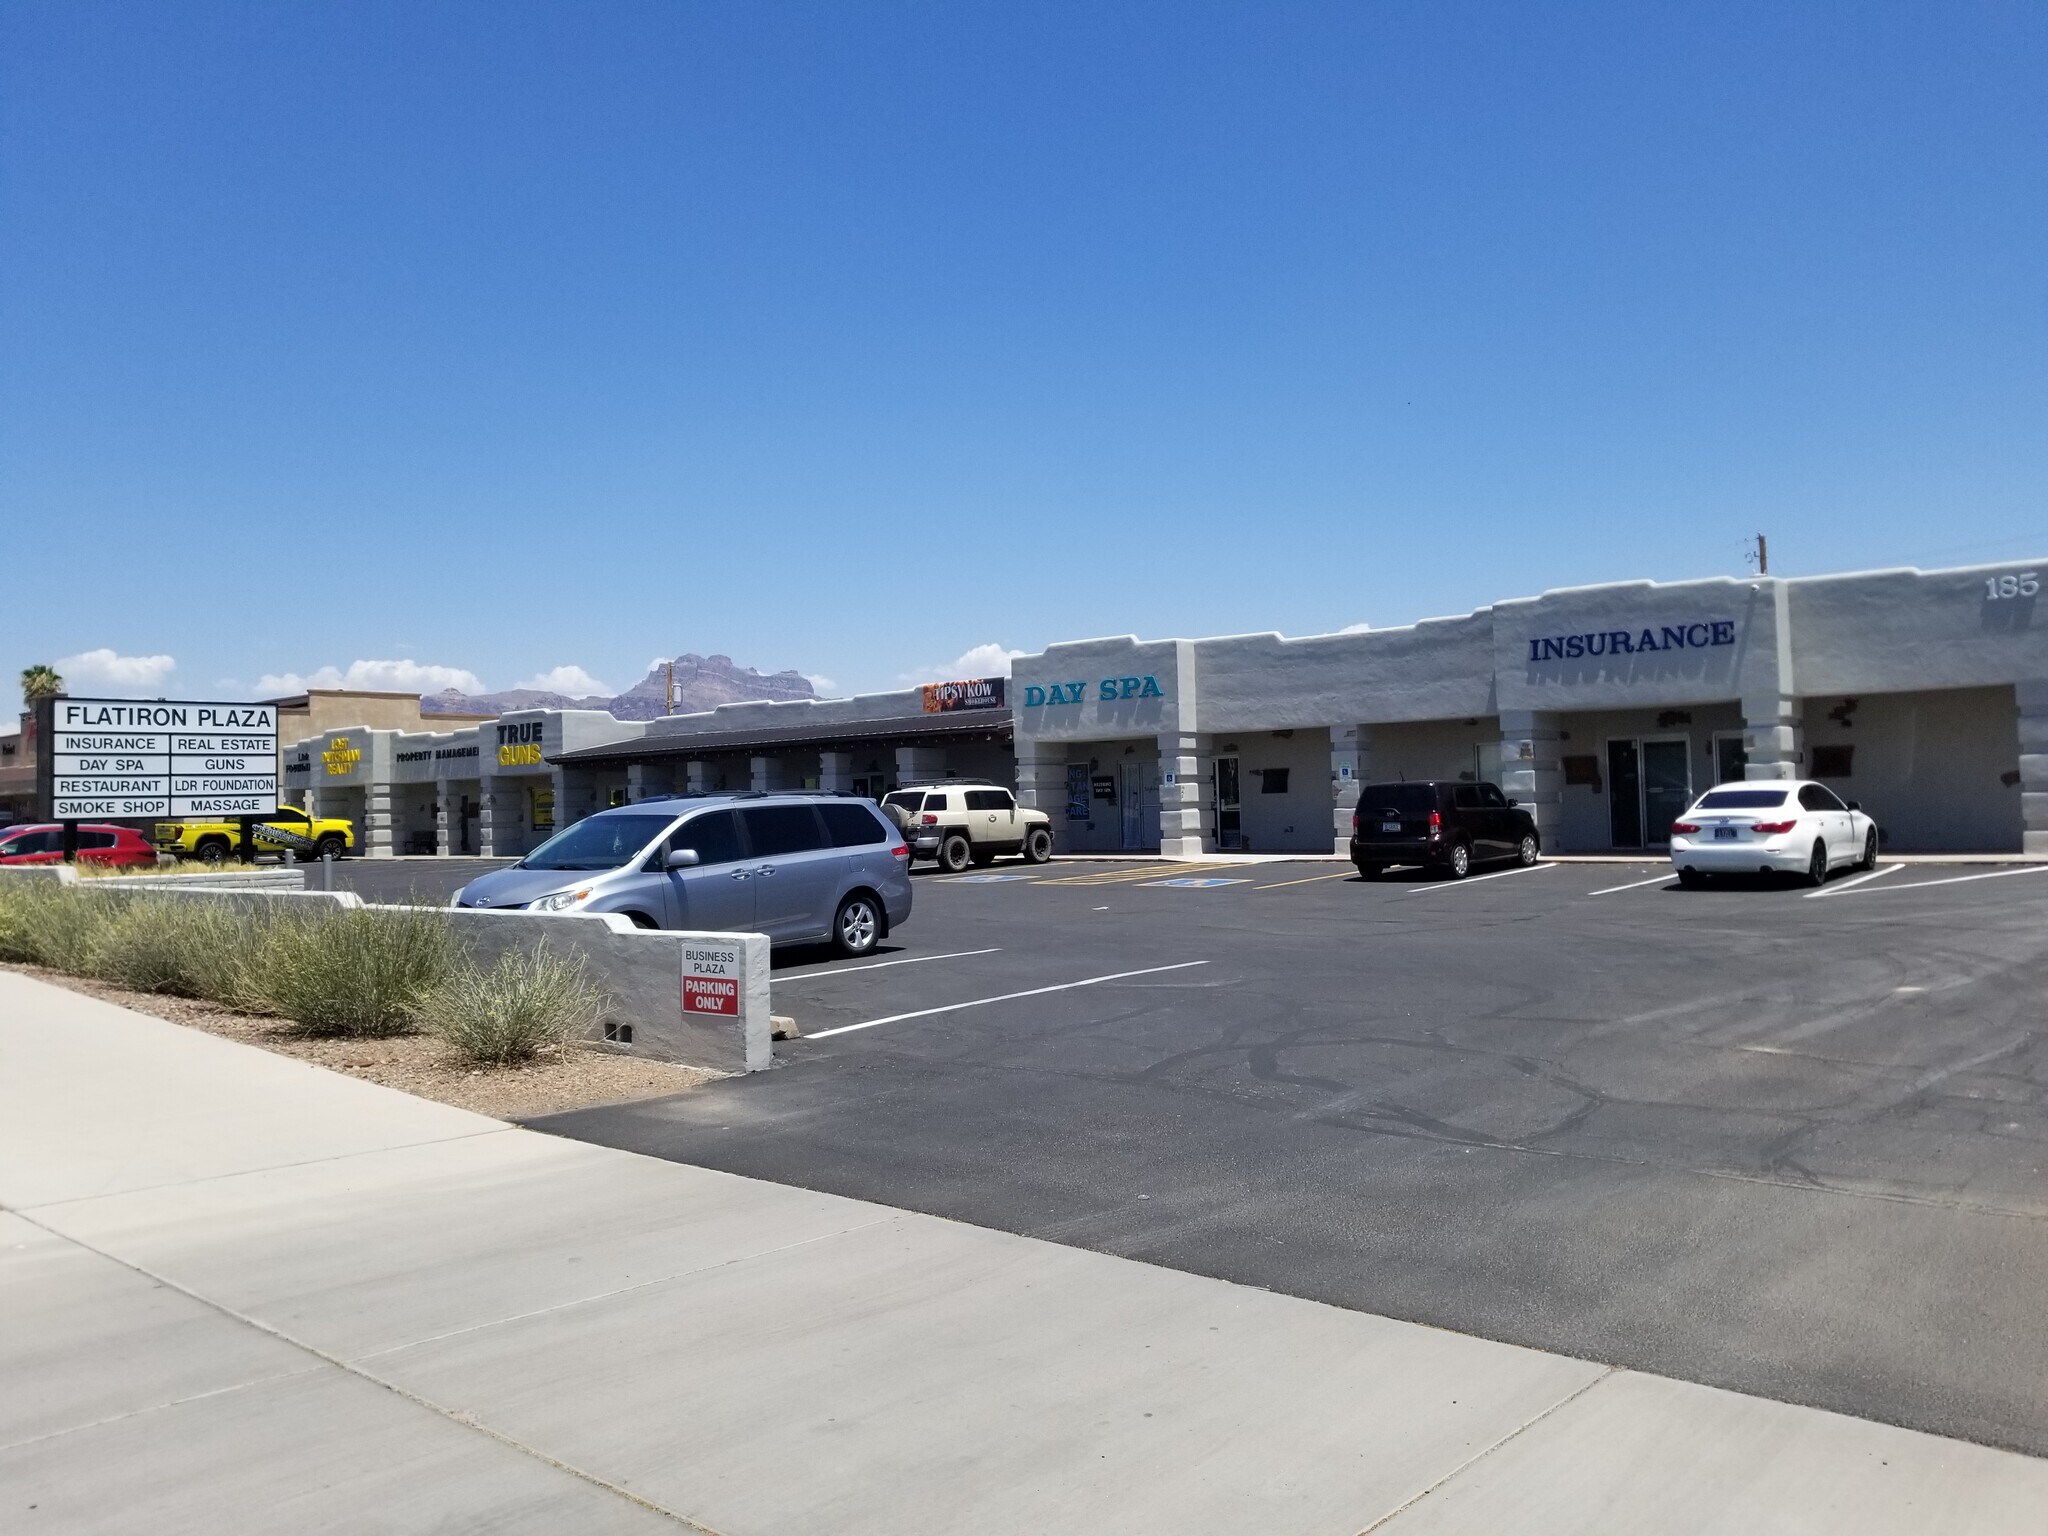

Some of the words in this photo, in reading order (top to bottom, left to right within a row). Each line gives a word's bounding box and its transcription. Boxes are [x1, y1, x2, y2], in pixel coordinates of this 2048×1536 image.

[1985, 572, 2039, 600] 185
[1530, 621, 1735, 661] INSURANCE
[934, 684, 963, 700] TIPSY
[967, 683, 992, 697] KOW
[1025, 682, 1087, 707] DAY
[1100, 675, 1164, 701] SPA
[67, 706, 187, 726] FLATIRON
[198, 709, 271, 727] PLAZA
[497, 722, 542, 744] TRUE
[66, 737, 156, 749] INSURANCE
[178, 739, 215, 750] REAL
[221, 739, 271, 750] ESTATE
[331, 737, 349, 750] LOST
[397, 750, 432, 762] PROPERTY
[498, 744, 541, 766] GUNS
[80, 760, 108, 771] DAY
[115, 759, 144, 771] SPA
[205, 759, 245, 770] GUNS
[328, 762, 352, 775] REALTY
[60, 780, 161, 792] RESTAURANT
[175, 780, 198, 791] LDR
[202, 779, 274, 791] FOUNDATION
[58, 802, 115, 814] SMOKE
[123, 801, 165, 813] SHOP
[191, 799, 260, 811] MASSAGE
[686, 950, 734, 962] BUSINESS
[694, 963, 725, 974] PLAZA
[685, 980, 734, 996] PARKING
[695, 996, 724, 1010] ONLY
